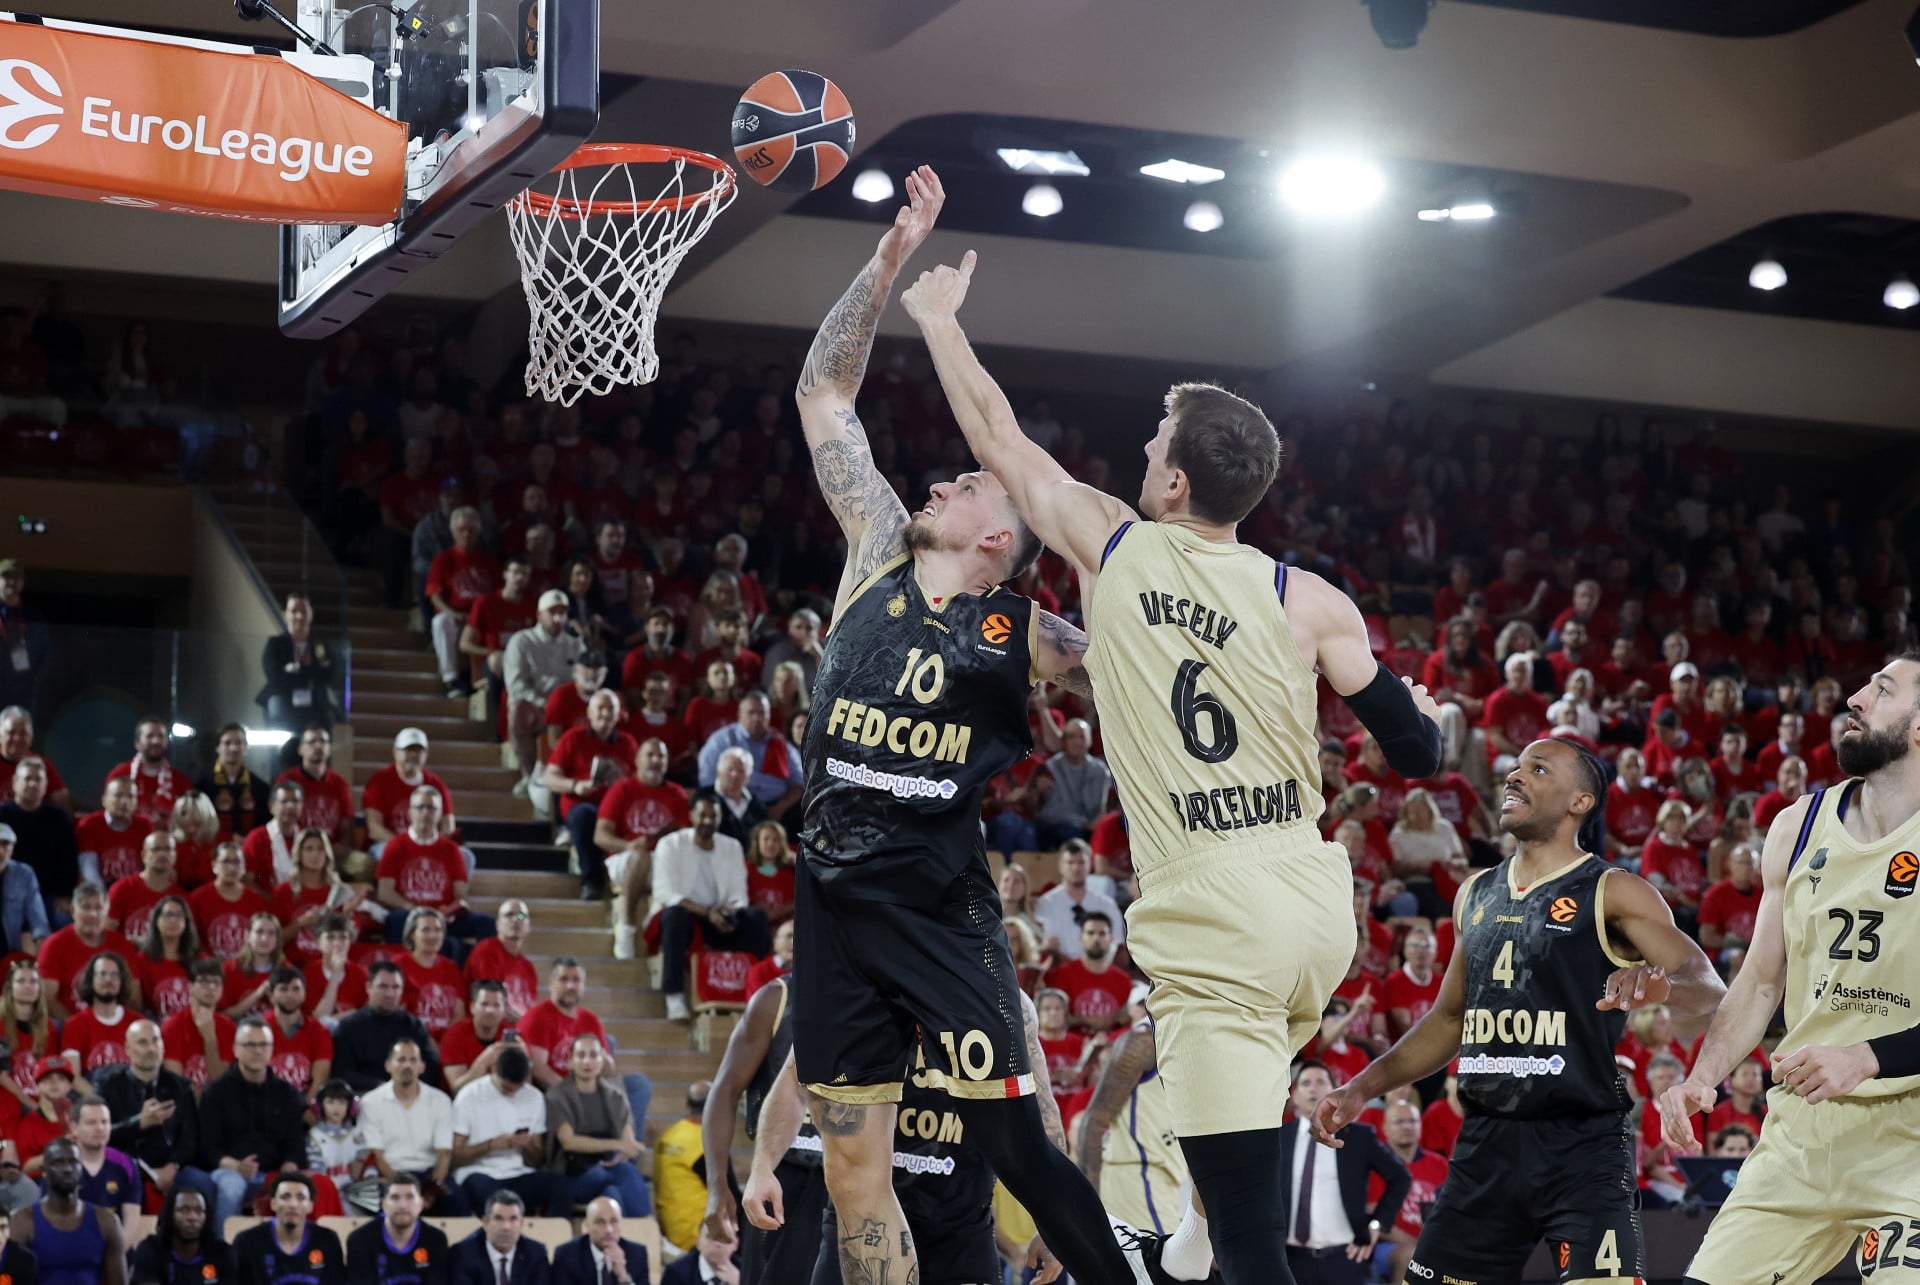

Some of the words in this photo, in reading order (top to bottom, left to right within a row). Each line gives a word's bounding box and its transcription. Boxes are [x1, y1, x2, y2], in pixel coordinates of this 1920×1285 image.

[82, 96, 373, 182] EuroLeague
[1139, 590, 1238, 650] VESELY
[977, 644, 1007, 656] EuroLeague
[894, 647, 945, 704] 10
[826, 697, 972, 764] FEDCOM
[1171, 658, 1239, 764] 6
[827, 758, 939, 797] zondacrypto
[1886, 884, 1913, 893] EuroLeague
[1495, 914, 1524, 924] SPALDING
[1545, 923, 1572, 932] EuroLeague
[1828, 907, 1884, 962] 23
[1492, 940, 1514, 989] 4
[1830, 997, 1889, 1017] Sanitària
[1832, 982, 1911, 1008] Assistència
[940, 1029, 994, 1081] 10
[899, 1108, 964, 1145] COM
[894, 1154, 943, 1174] crypto
[864, 1233, 882, 1247] 27
[1594, 1229, 1622, 1277] 4
[1879, 1219, 1920, 1270] 23
[1408, 1259, 1434, 1279] ONACO
